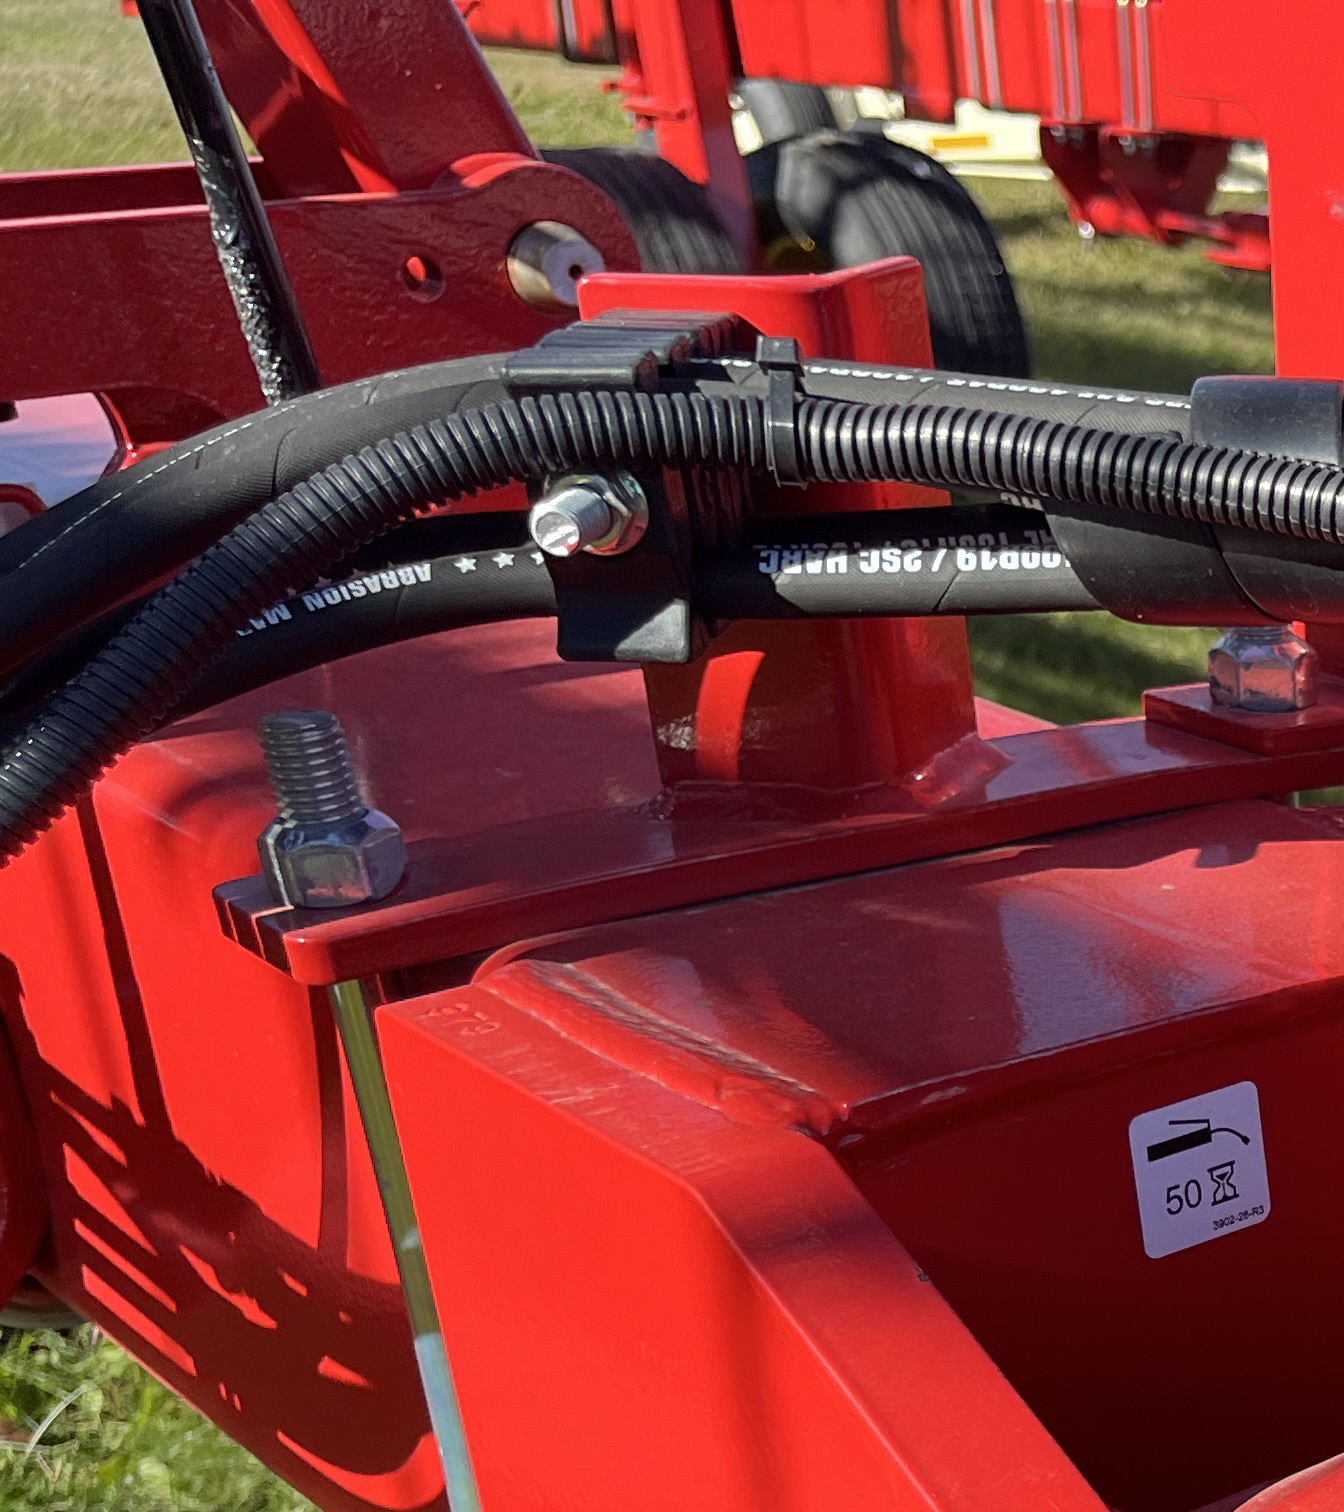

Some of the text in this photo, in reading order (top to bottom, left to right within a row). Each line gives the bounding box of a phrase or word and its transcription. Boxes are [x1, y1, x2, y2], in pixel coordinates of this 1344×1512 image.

[859, 548, 923, 574] 2SC
[956, 548, 1072, 573] 00R19
[302, 562, 432, 611] ABRASION
[1166, 1179, 1202, 1215] 50
